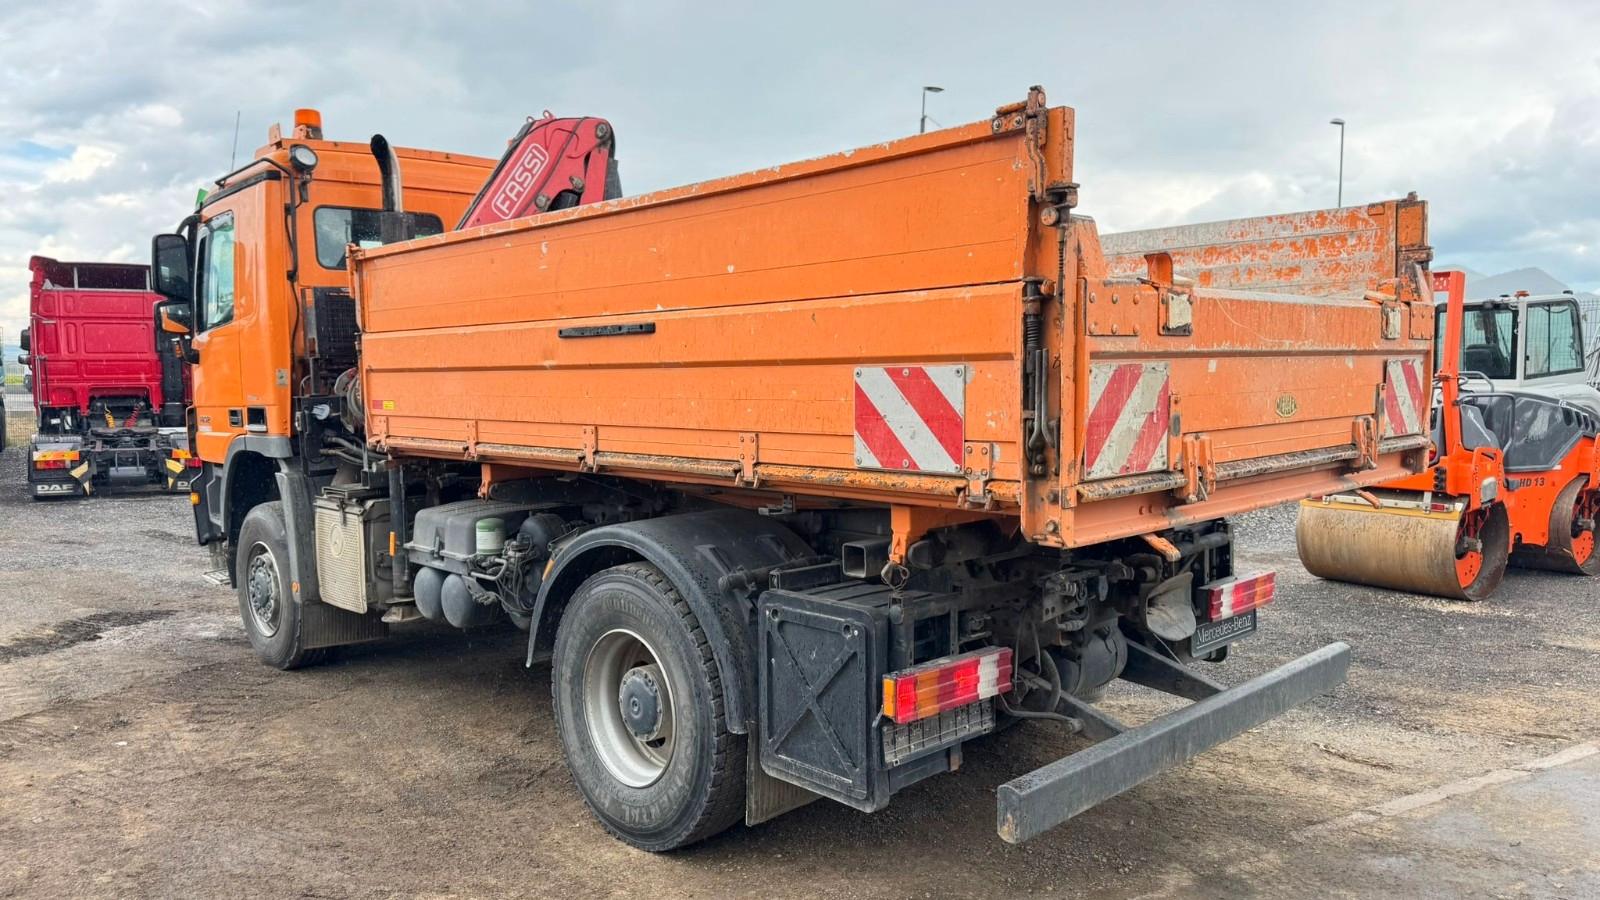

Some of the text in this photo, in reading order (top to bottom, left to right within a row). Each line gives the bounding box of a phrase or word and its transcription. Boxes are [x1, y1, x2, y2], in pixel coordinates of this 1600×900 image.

[496, 149, 545, 214] FASSI
[1520, 477, 1545, 487] HD 13
[1197, 615, 1252, 645] Mercedes-Benz
